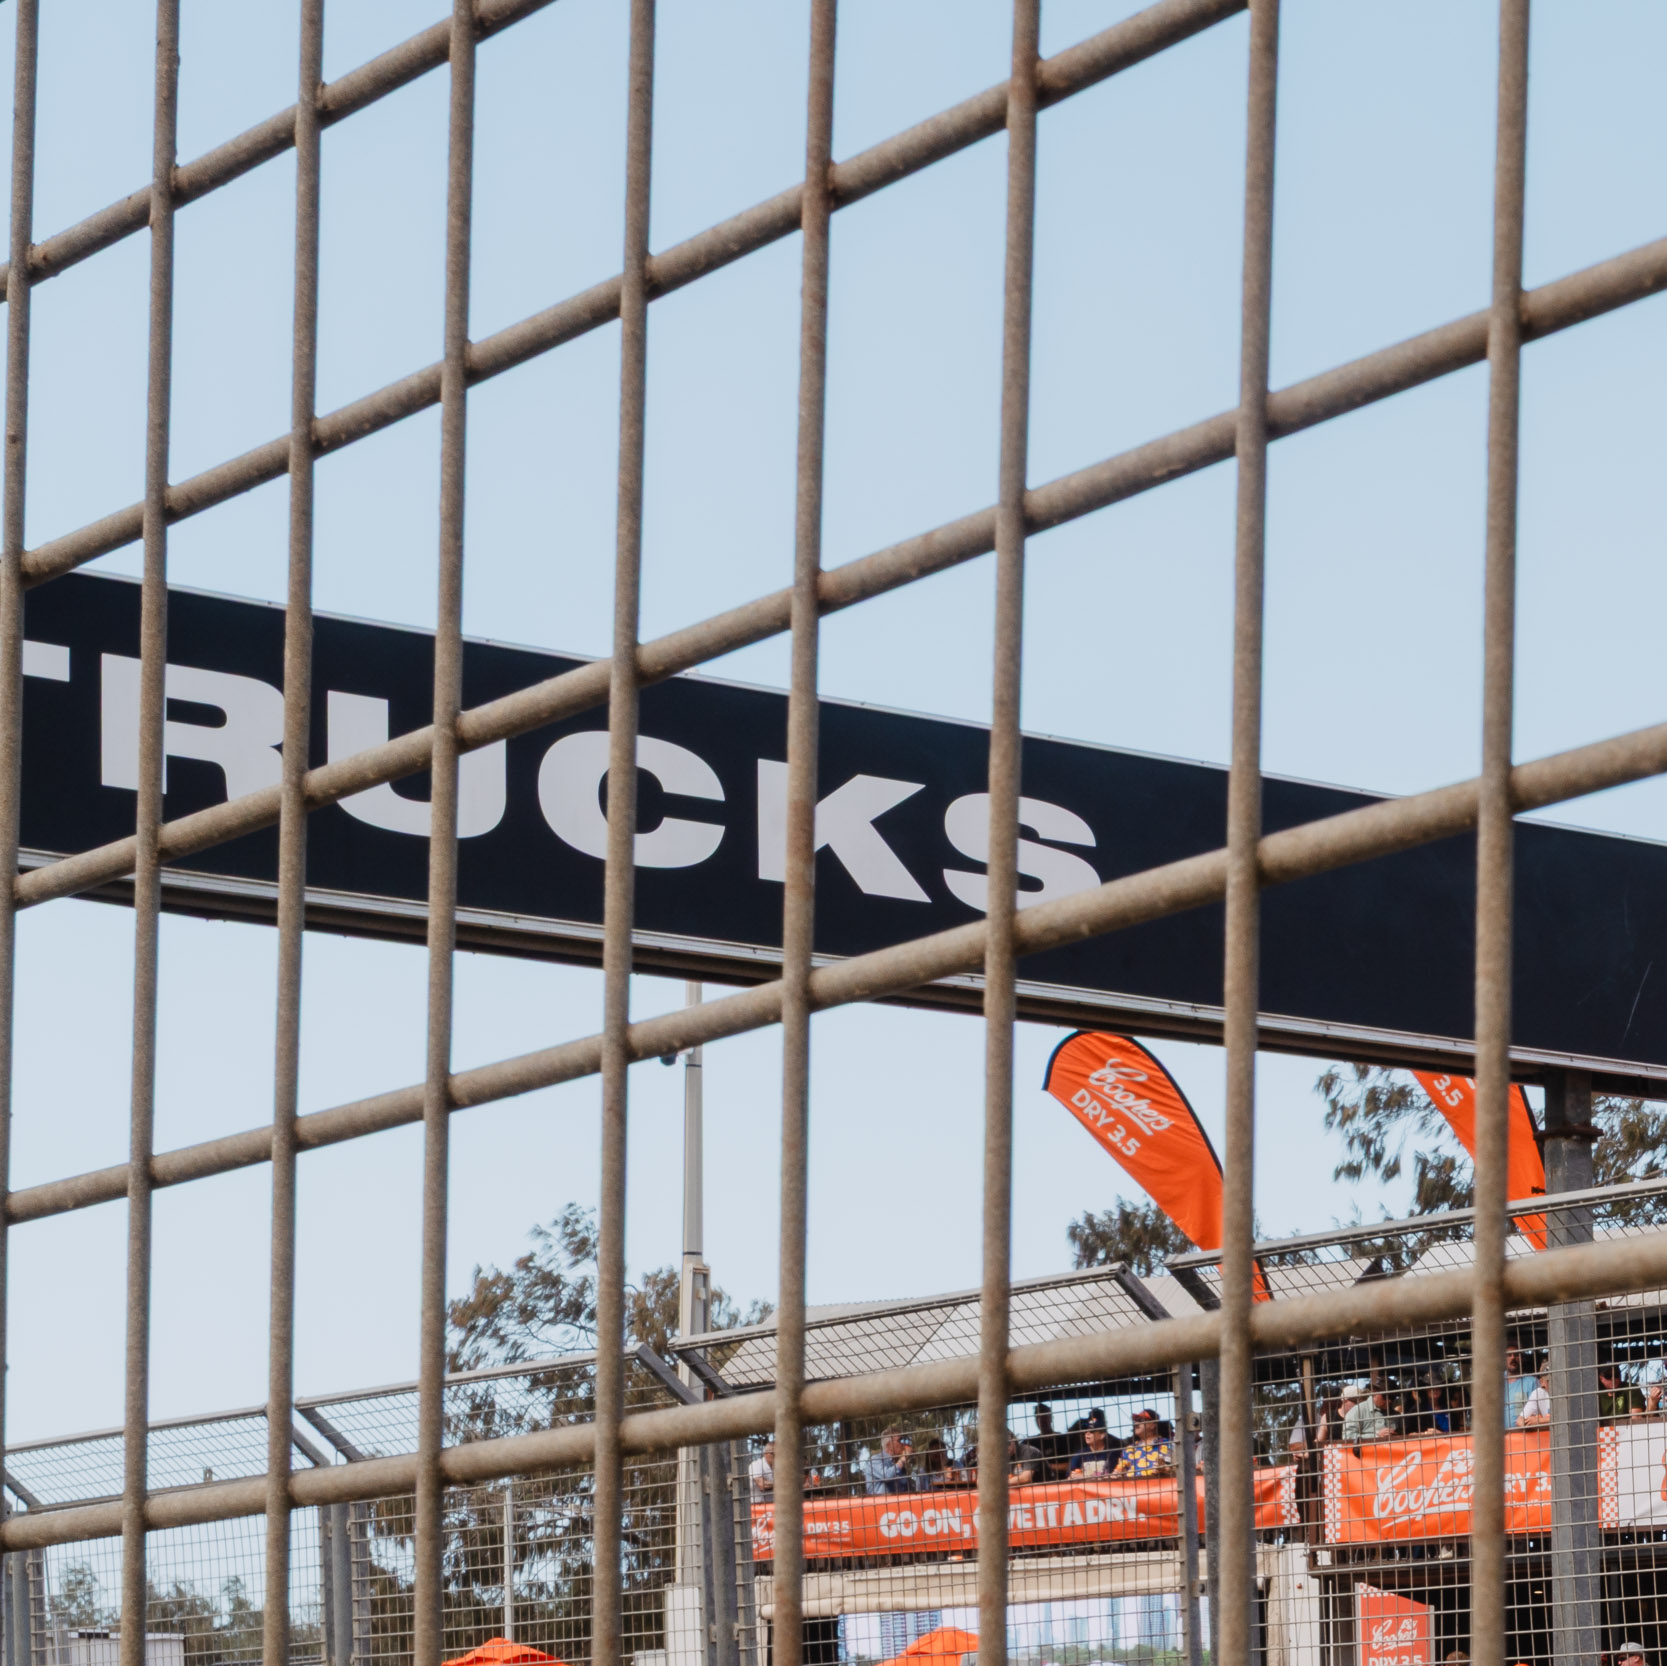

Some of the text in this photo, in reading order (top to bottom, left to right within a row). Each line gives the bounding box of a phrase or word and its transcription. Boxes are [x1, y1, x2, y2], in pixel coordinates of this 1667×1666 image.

[23, 640, 1103, 914] RUCKS
[1071, 1088, 1141, 1156] DRY 3.5
[1088, 1058, 1174, 1133] Coopers
[1433, 1074, 1464, 1107] 3.5
[879, 1510, 918, 1538] GO
